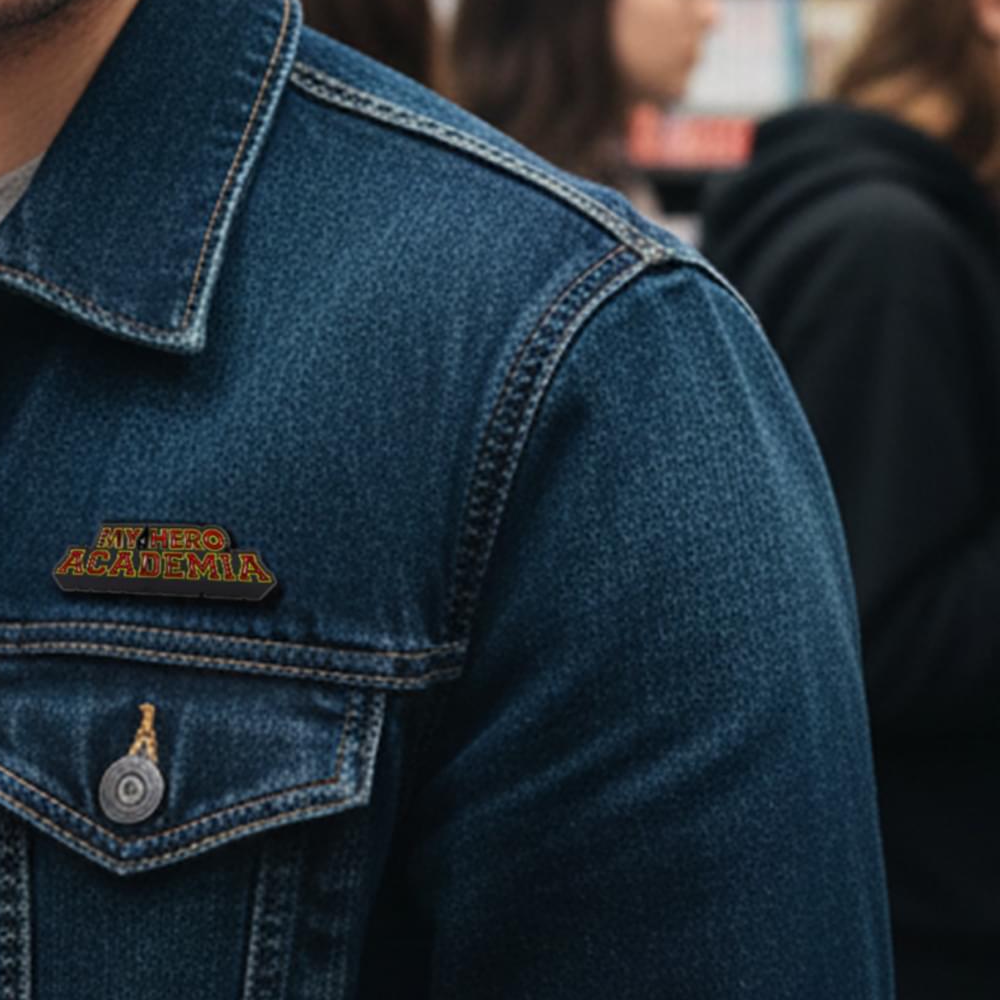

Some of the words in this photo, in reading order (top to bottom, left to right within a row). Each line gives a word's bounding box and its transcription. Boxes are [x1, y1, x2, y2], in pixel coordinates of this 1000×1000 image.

[97, 527, 141, 549] MY
[150, 527, 226, 550] HERO
[55, 549, 272, 584] ACADEMIA
